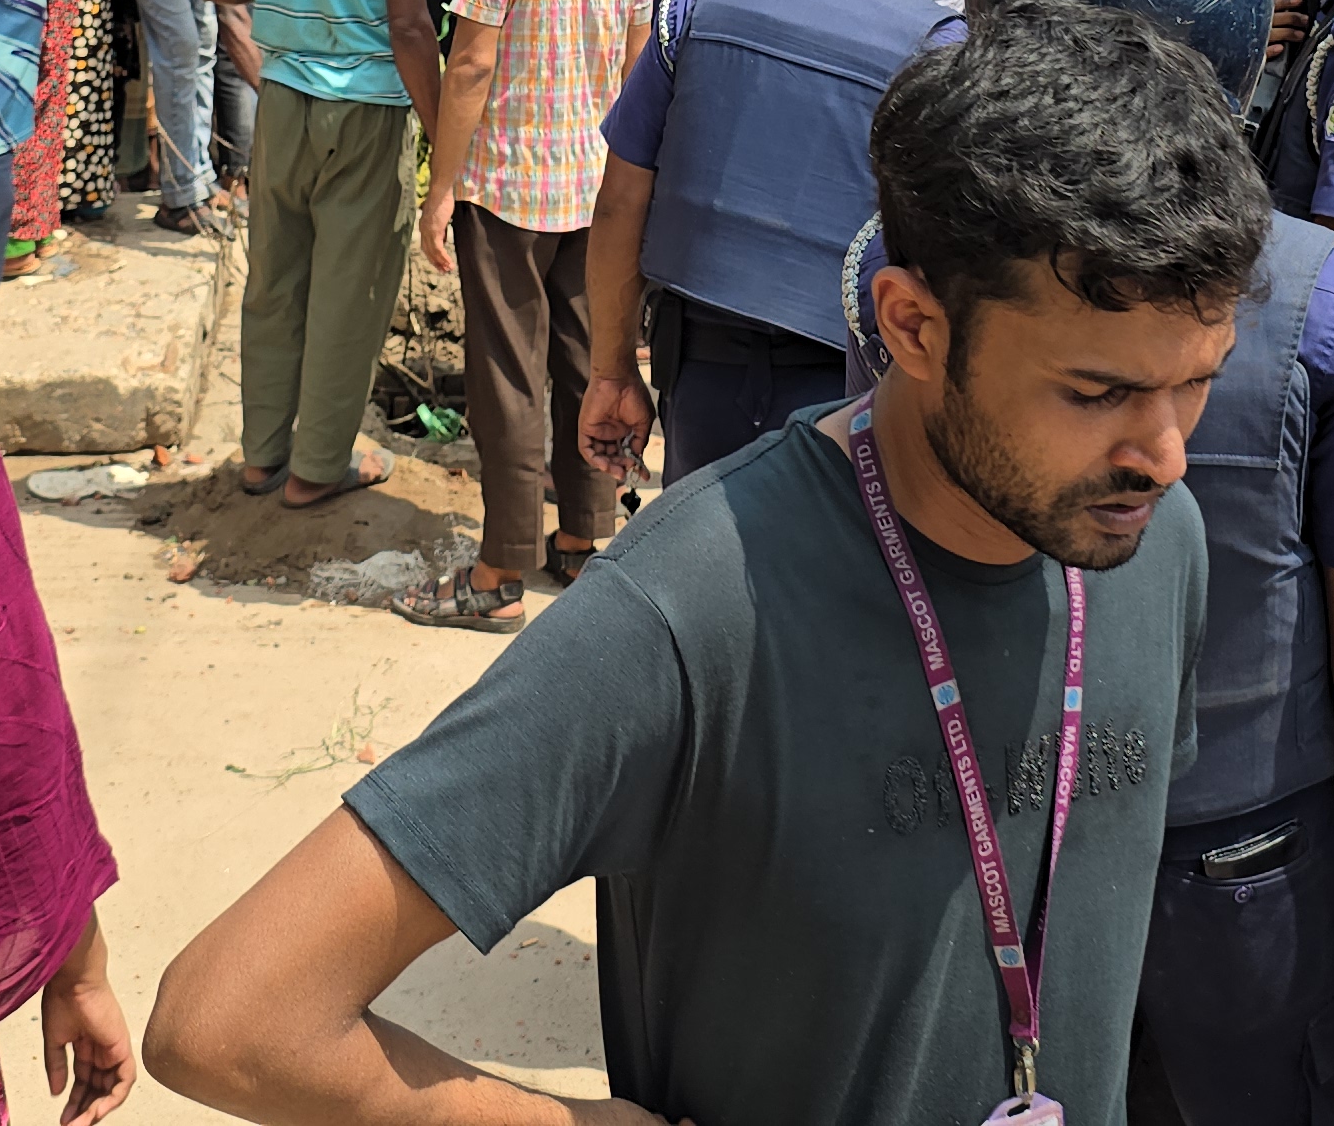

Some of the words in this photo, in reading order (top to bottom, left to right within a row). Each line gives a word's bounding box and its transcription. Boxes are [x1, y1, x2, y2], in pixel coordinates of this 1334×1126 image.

[867, 481, 916, 585] GARMENTS
[906, 590, 945, 671] MASCOT
[1066, 566, 1084, 633] MENTS
[957, 756, 995, 857] GARMENTS
[1057, 725, 1076, 807] MASCOT
[981, 861, 1011, 934] MASCOT
